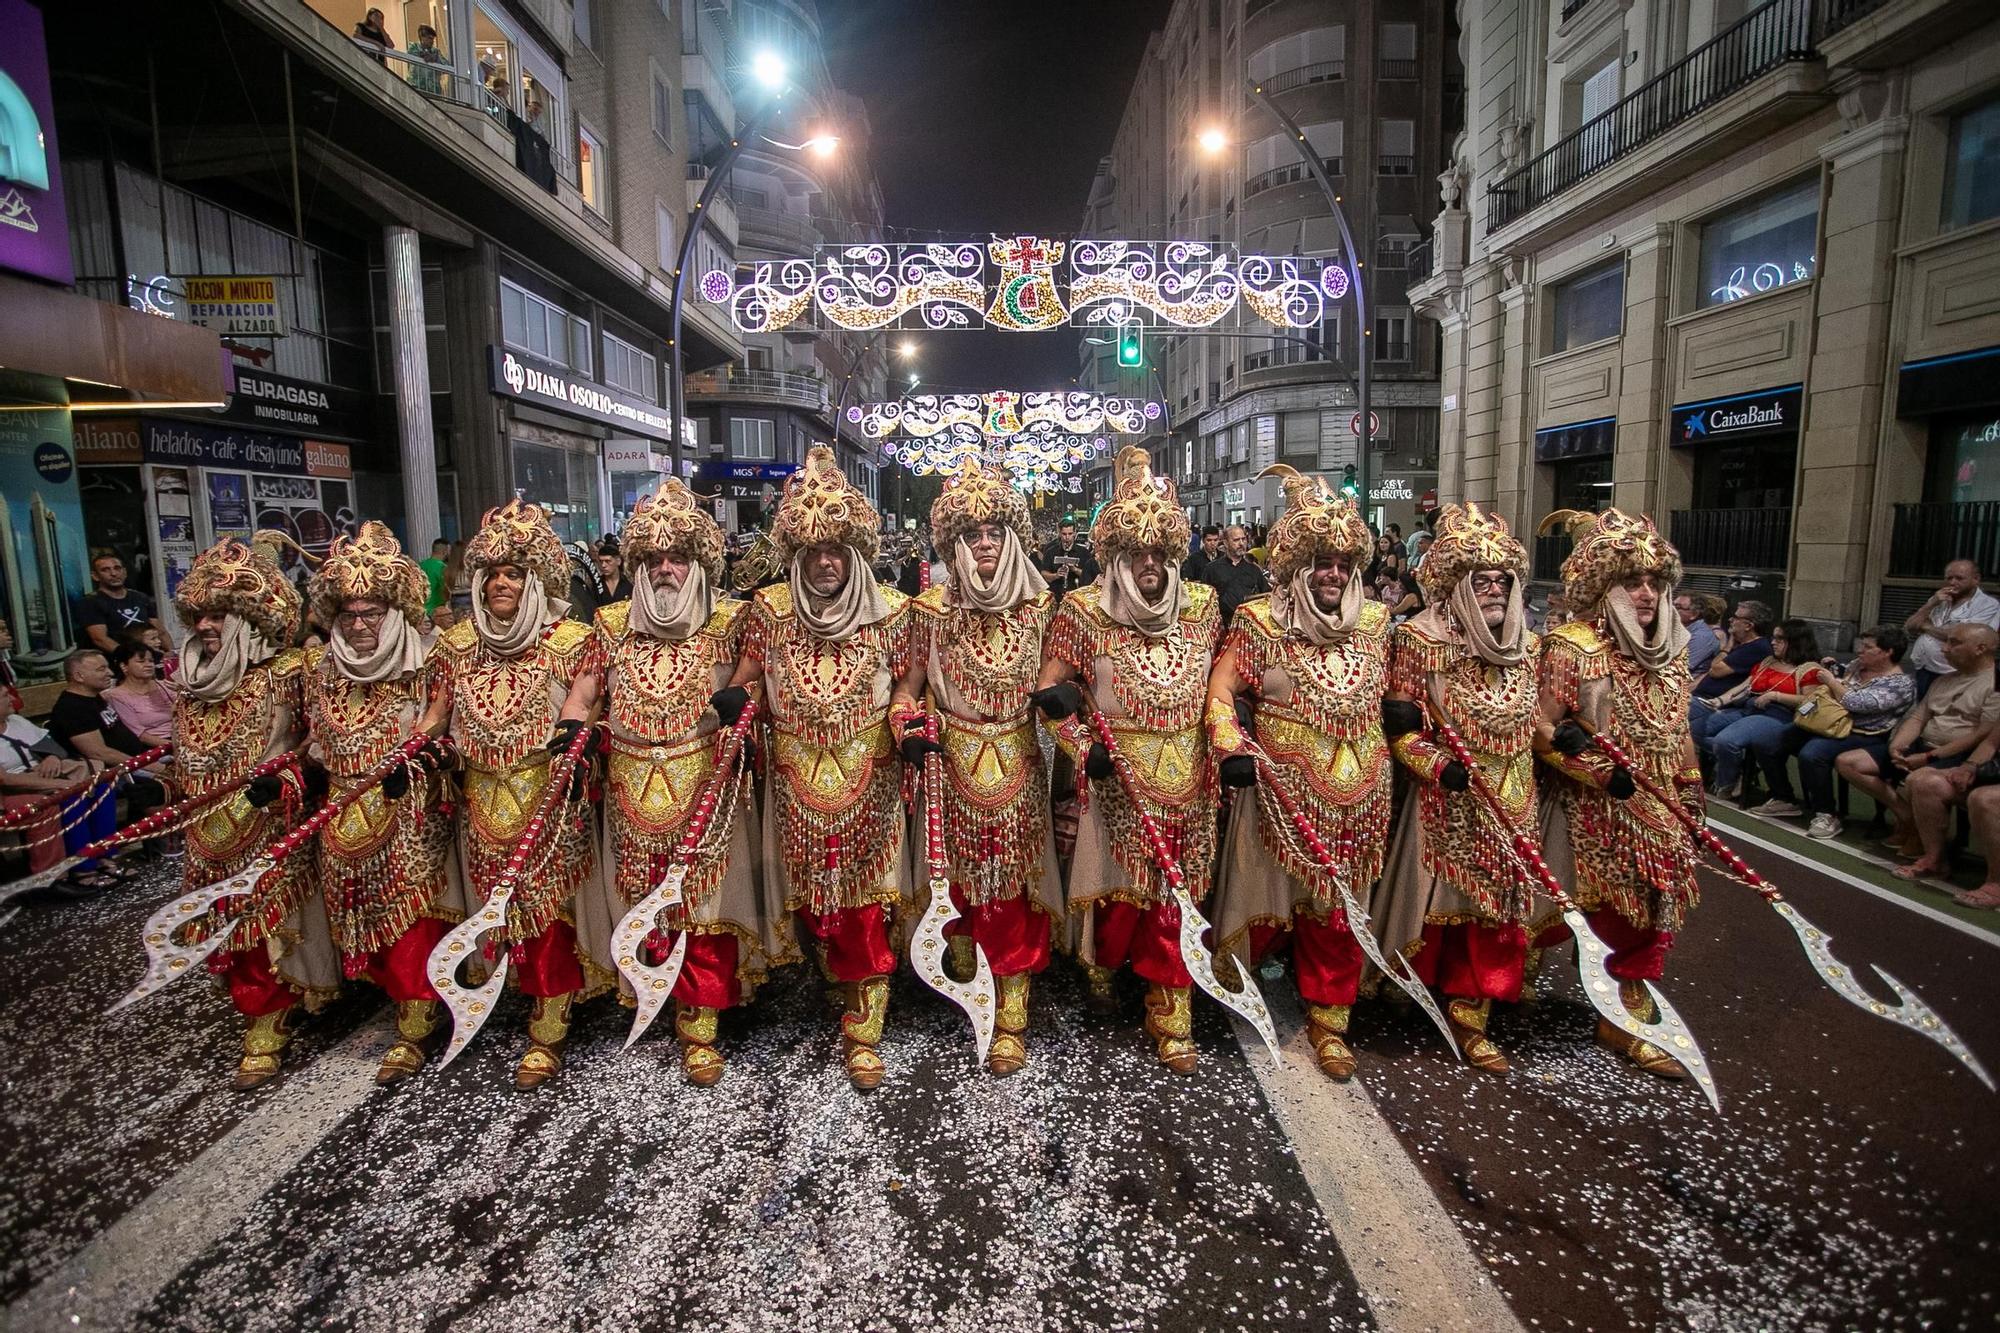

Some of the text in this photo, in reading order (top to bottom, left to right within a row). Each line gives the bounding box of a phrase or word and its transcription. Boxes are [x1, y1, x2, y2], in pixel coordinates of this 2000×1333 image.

[186, 282, 274, 300] TACON MINUTO
[191, 304, 274, 316] REPARACION
[228, 320, 275, 332] ALZADO
[239, 376, 329, 409] EURAGASA
[525, 368, 568, 401] DIANA
[569, 384, 612, 415] OSORIO
[254, 405, 319, 425] INMOBILIARIA
[1710, 401, 1783, 429] CaixaBank
[73, 423, 140, 450] aliano
[151, 427, 202, 457] helados
[306, 445, 350, 472] galiano
[608, 451, 646, 460] ADARA
[733, 468, 753, 477] MGS
[731, 486, 747, 497] TZ
